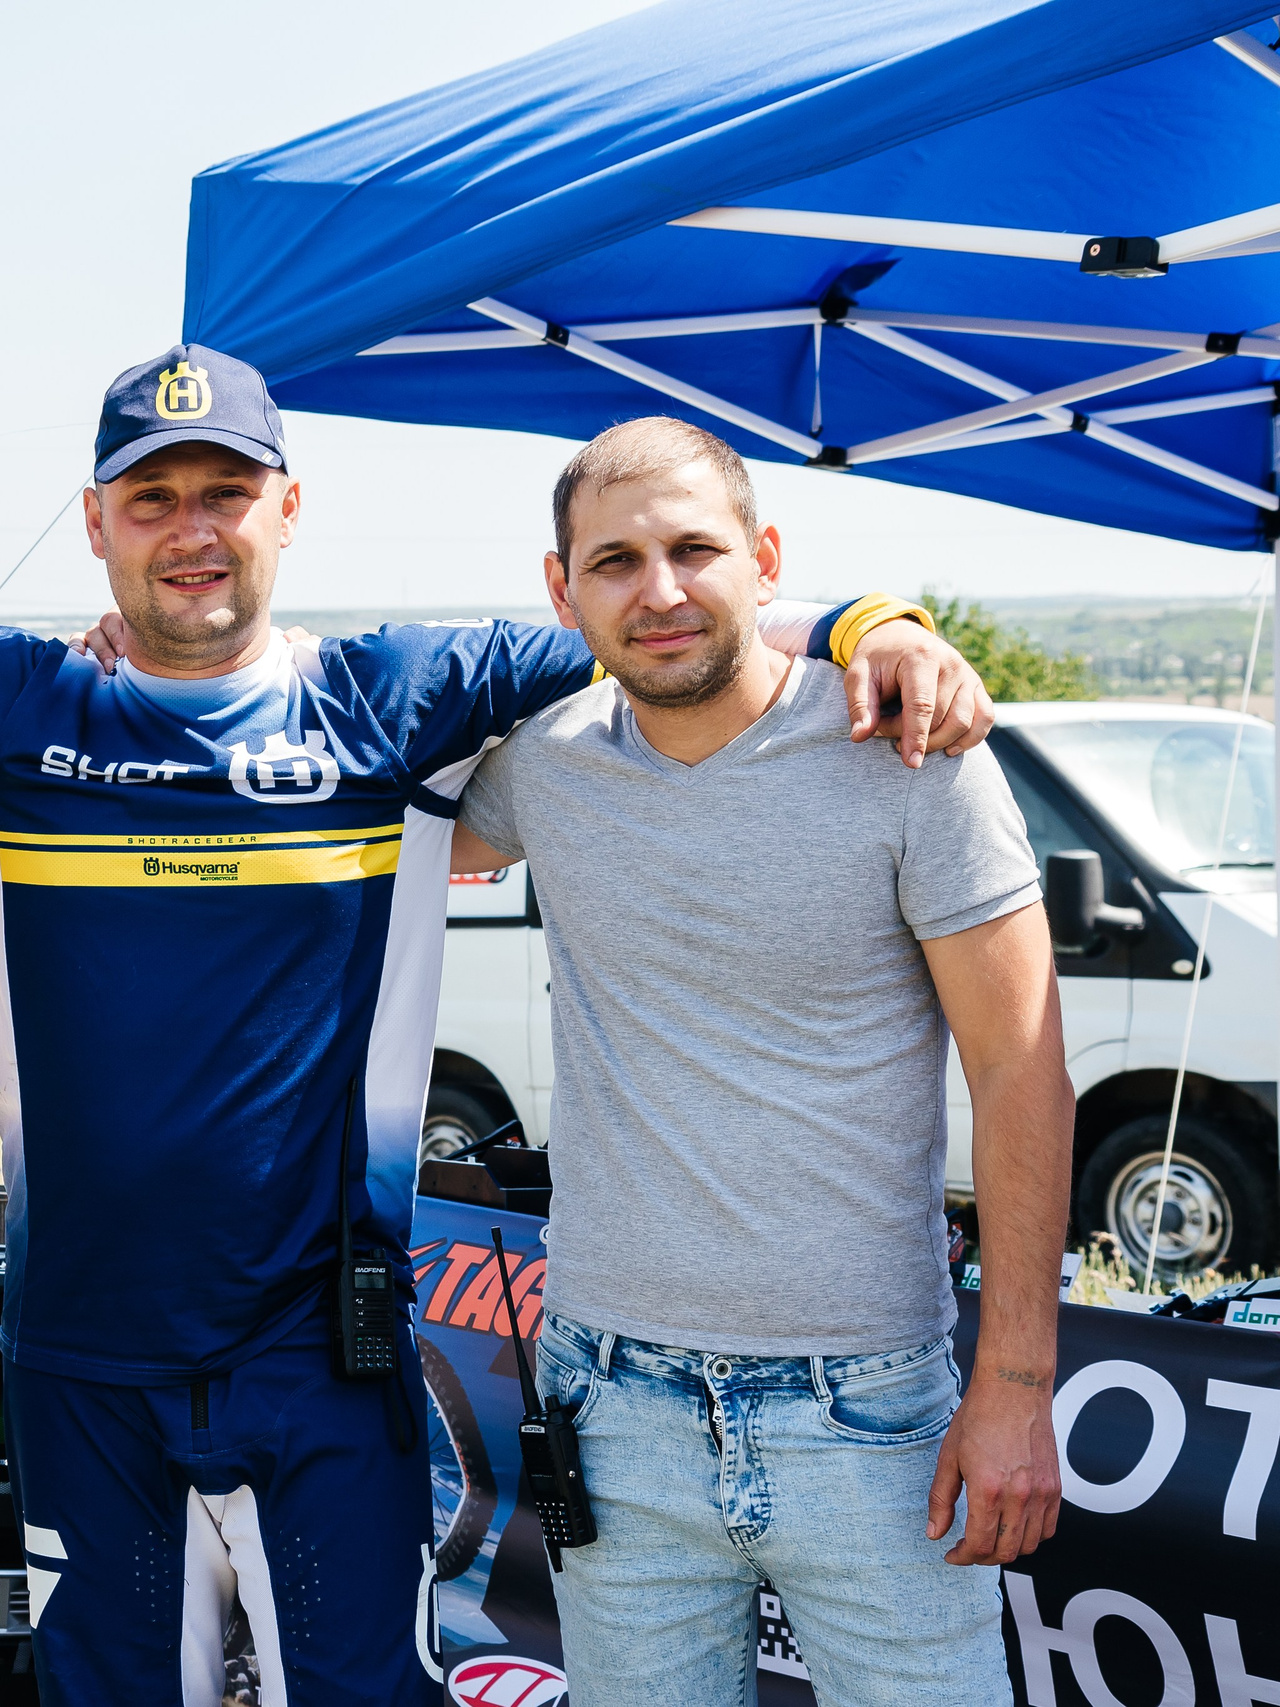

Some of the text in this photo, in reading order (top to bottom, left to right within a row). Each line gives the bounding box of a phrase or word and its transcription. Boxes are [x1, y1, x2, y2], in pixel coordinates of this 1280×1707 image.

[41, 744, 190, 784] SHOT
[162, 861, 239, 876] Husqvarna
[424, 1242, 548, 1342] TAG
